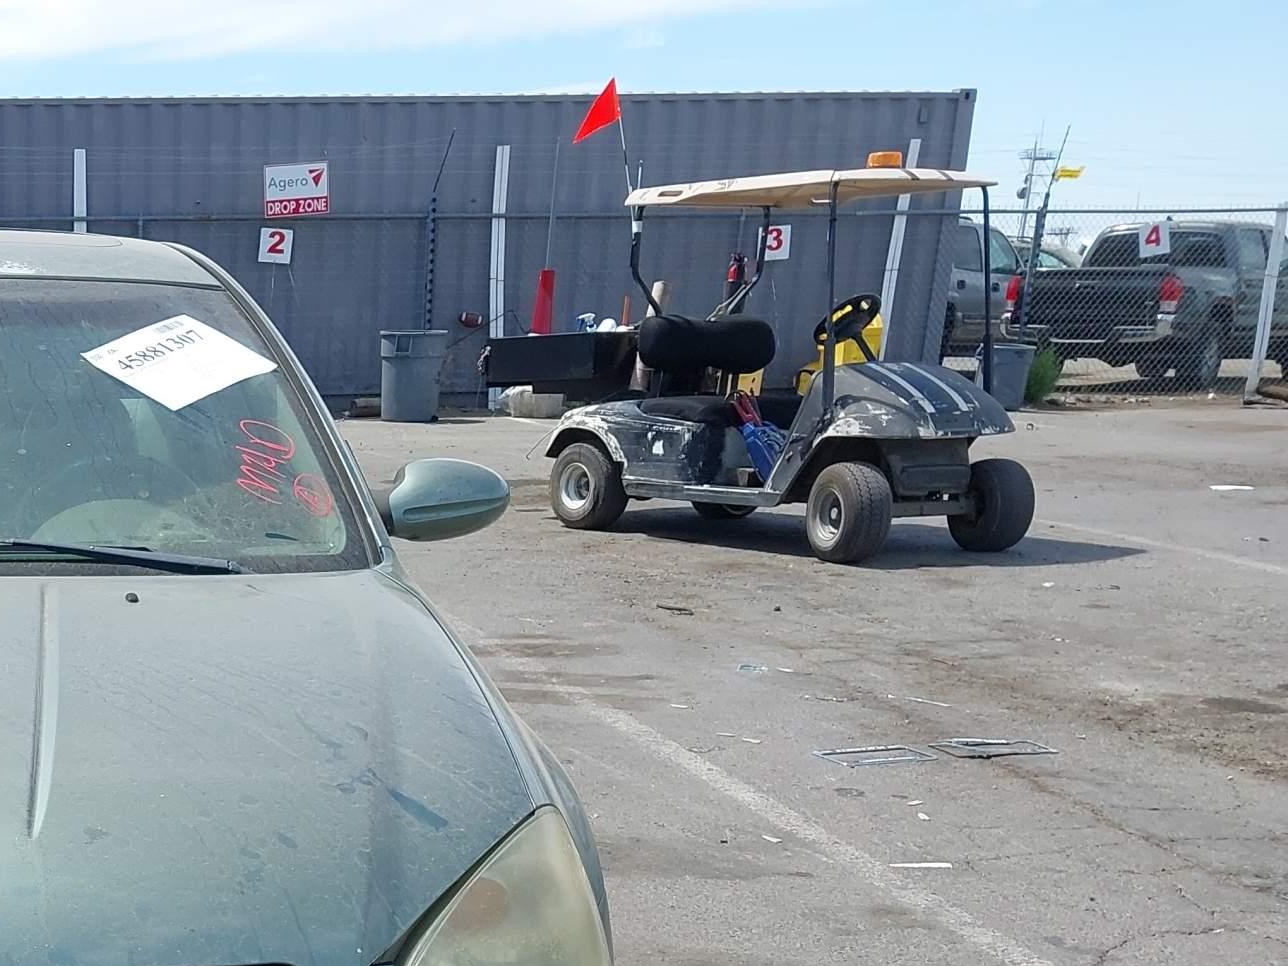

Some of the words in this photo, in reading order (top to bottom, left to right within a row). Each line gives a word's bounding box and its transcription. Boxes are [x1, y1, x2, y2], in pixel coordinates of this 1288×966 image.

[268, 177, 308, 191] Agero
[267, 202, 296, 215] DROP
[299, 198, 327, 212] ZONE
[266, 230, 285, 254] 2
[767, 228, 783, 251] 3
[1144, 224, 1161, 247] 4
[117, 329, 205, 371] 45881307
